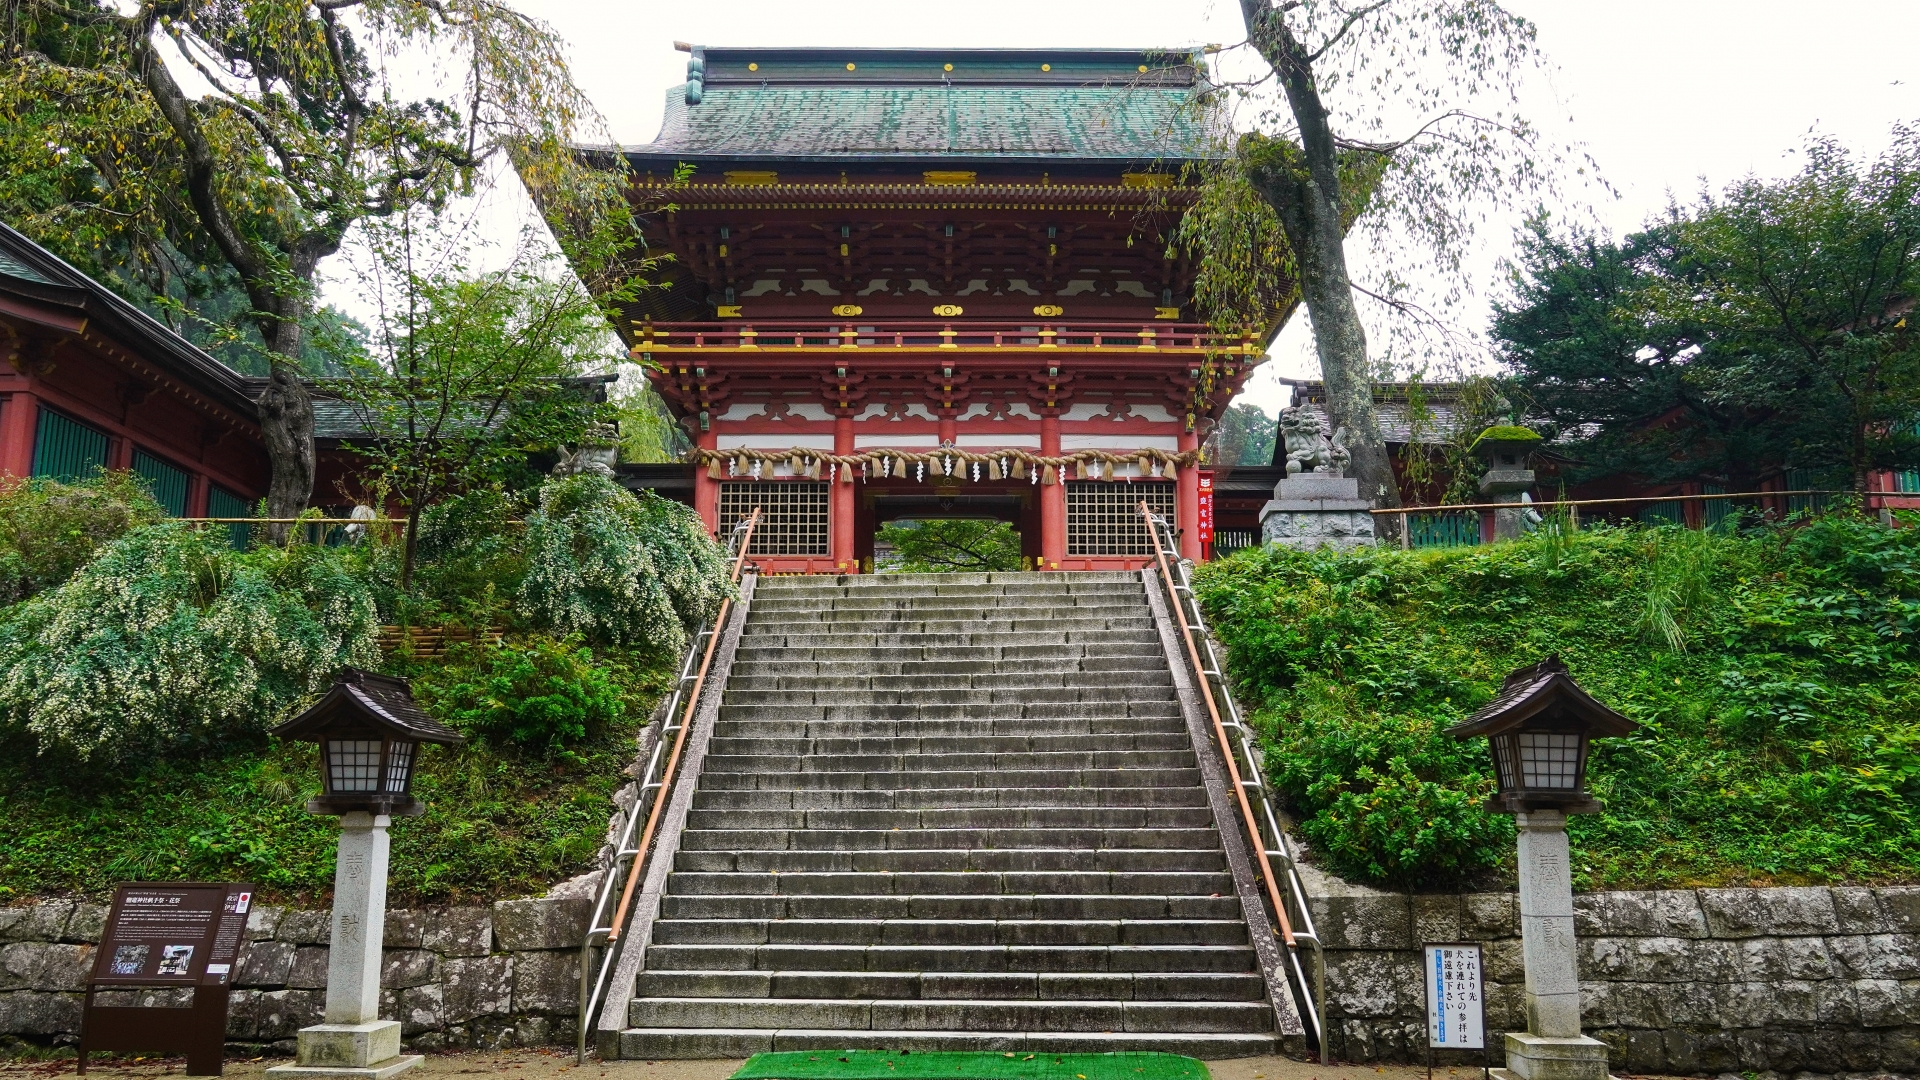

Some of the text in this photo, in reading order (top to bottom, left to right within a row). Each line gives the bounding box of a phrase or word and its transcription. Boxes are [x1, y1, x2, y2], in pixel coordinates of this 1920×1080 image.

[1444, 950, 1454, 1010] 御遠慮下さい
[1456, 950, 1468, 1044] 犬を連れての参拝は
[1466, 950, 1478, 1002] これより先
